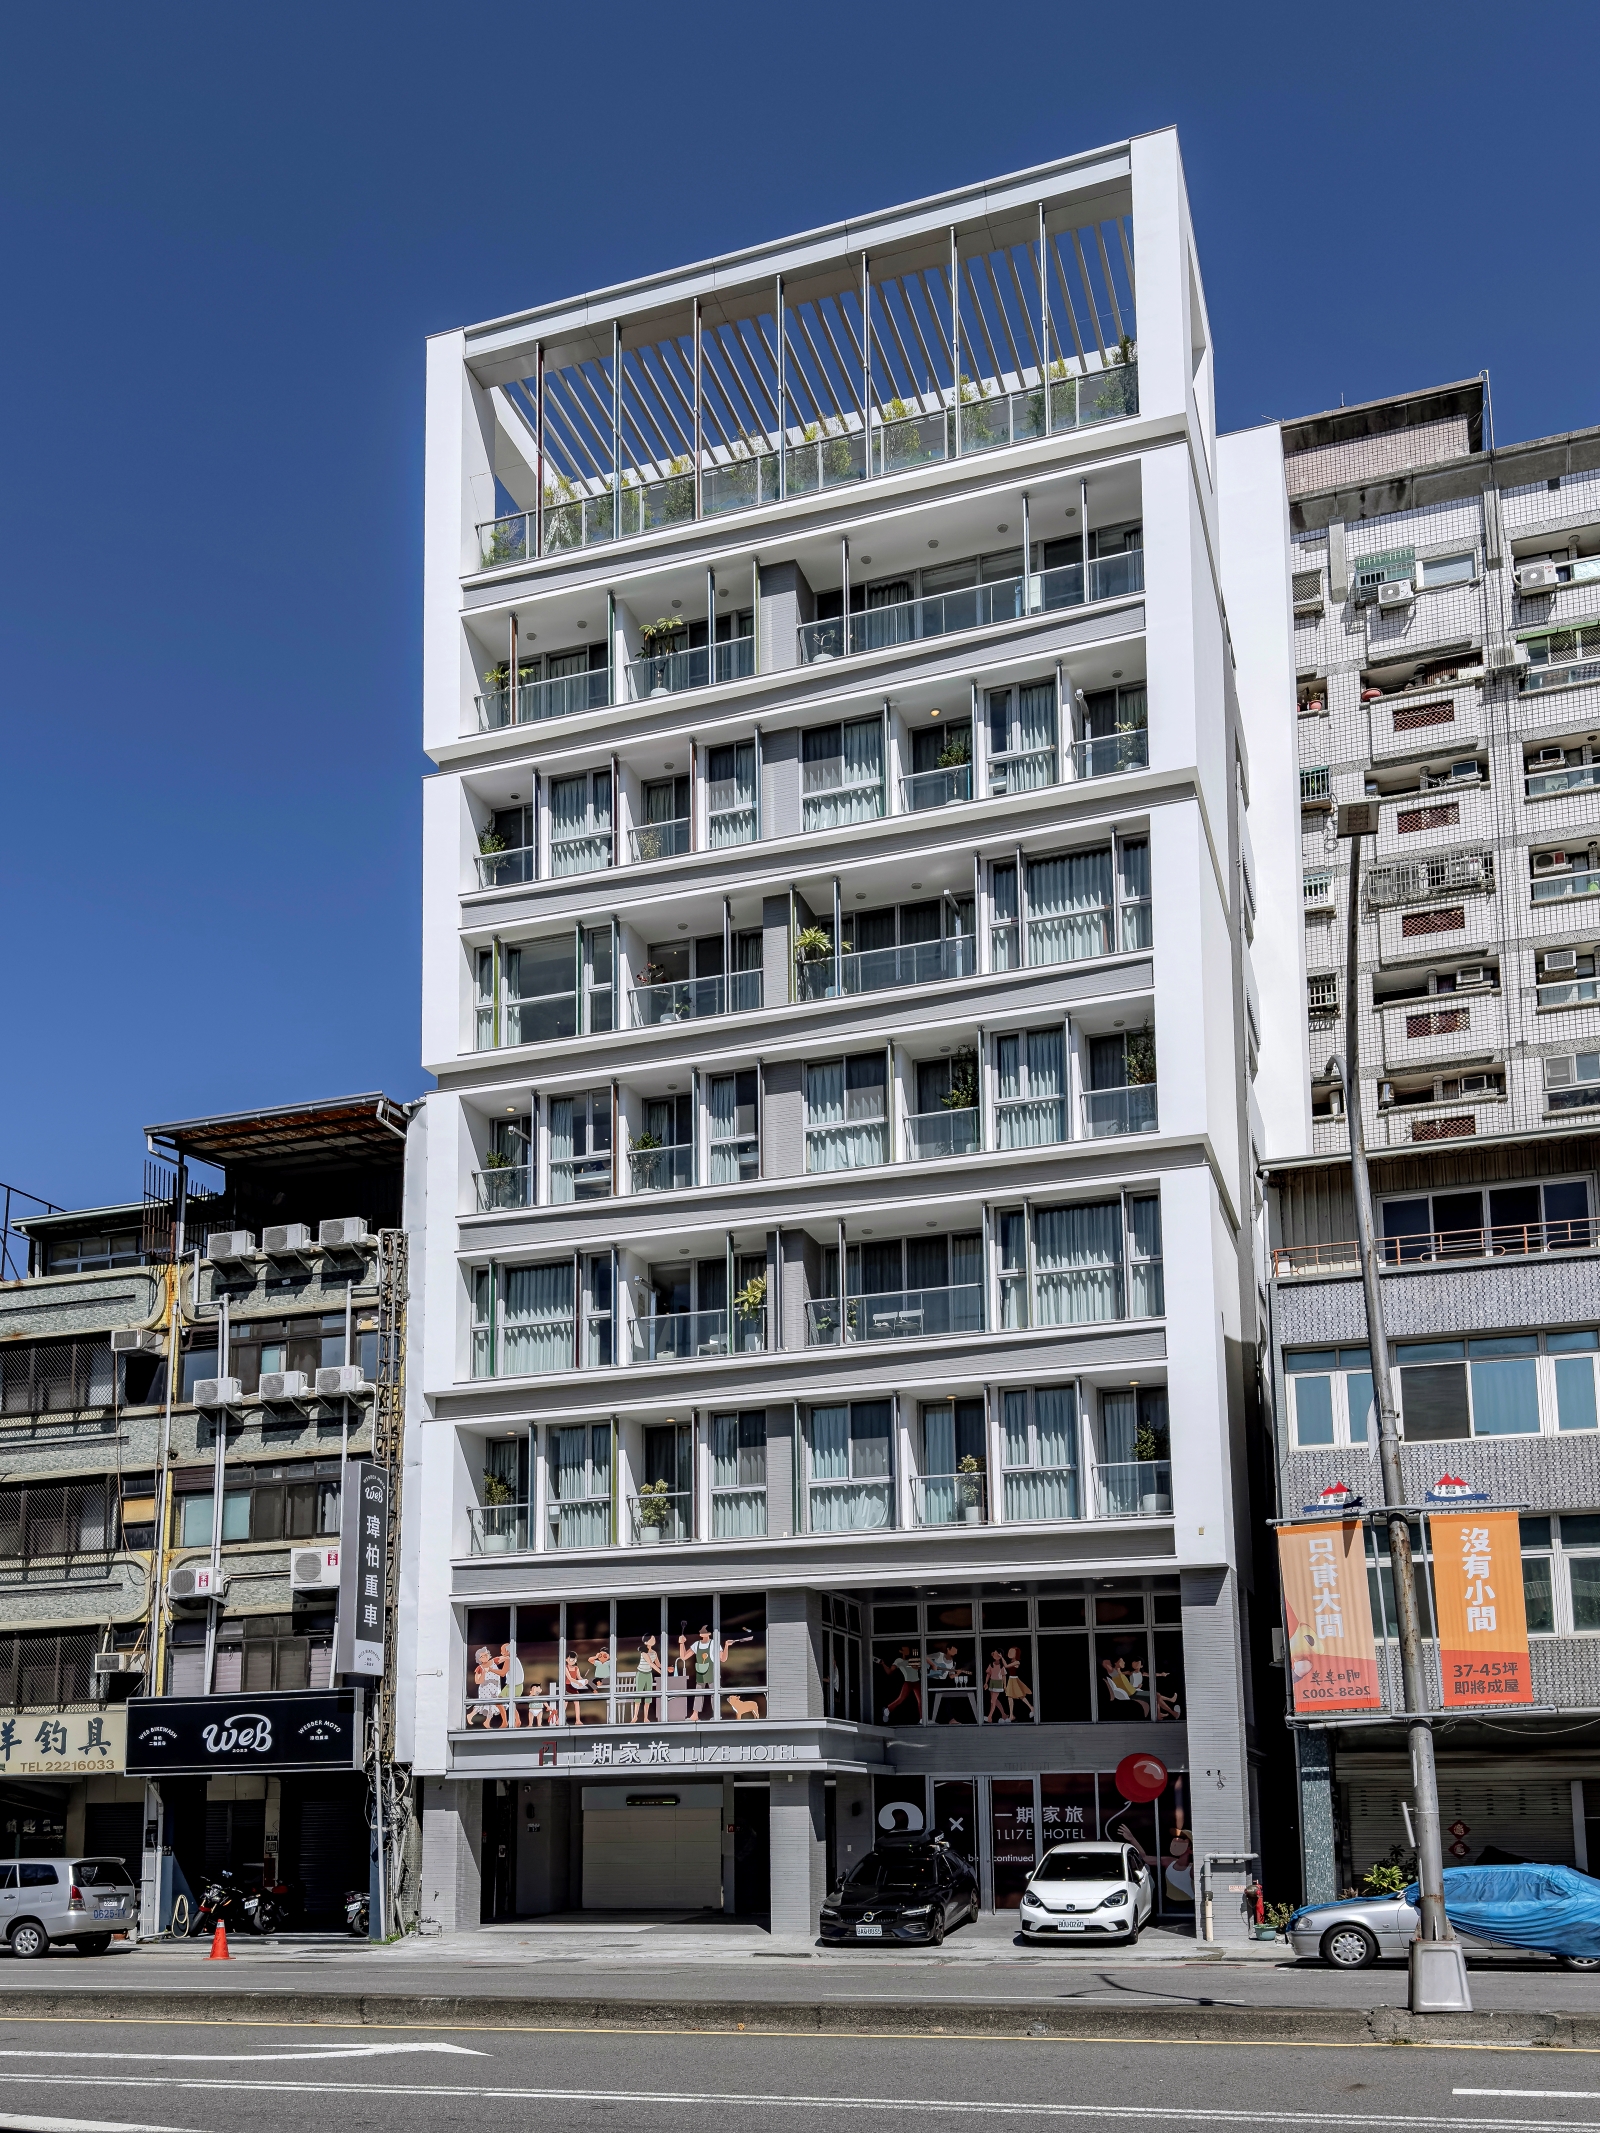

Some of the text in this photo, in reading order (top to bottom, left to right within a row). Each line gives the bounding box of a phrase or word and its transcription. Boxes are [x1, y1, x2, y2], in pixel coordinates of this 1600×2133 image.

[363, 1515, 381, 1628] 瑋柏重車
[1460, 1527, 1497, 1632] 沒有小間
[1453, 1662, 1519, 1678] 37-45坪
[1454, 1678, 1520, 1695] 即將成屋
[324, 1720, 341, 1733] MOTO
[740, 1745, 799, 1760] HOTEL
[995, 1806, 1083, 1823] 一期家旅
[1043, 1828, 1086, 1839] HOTEL
[994, 1853, 1034, 1862] continued
